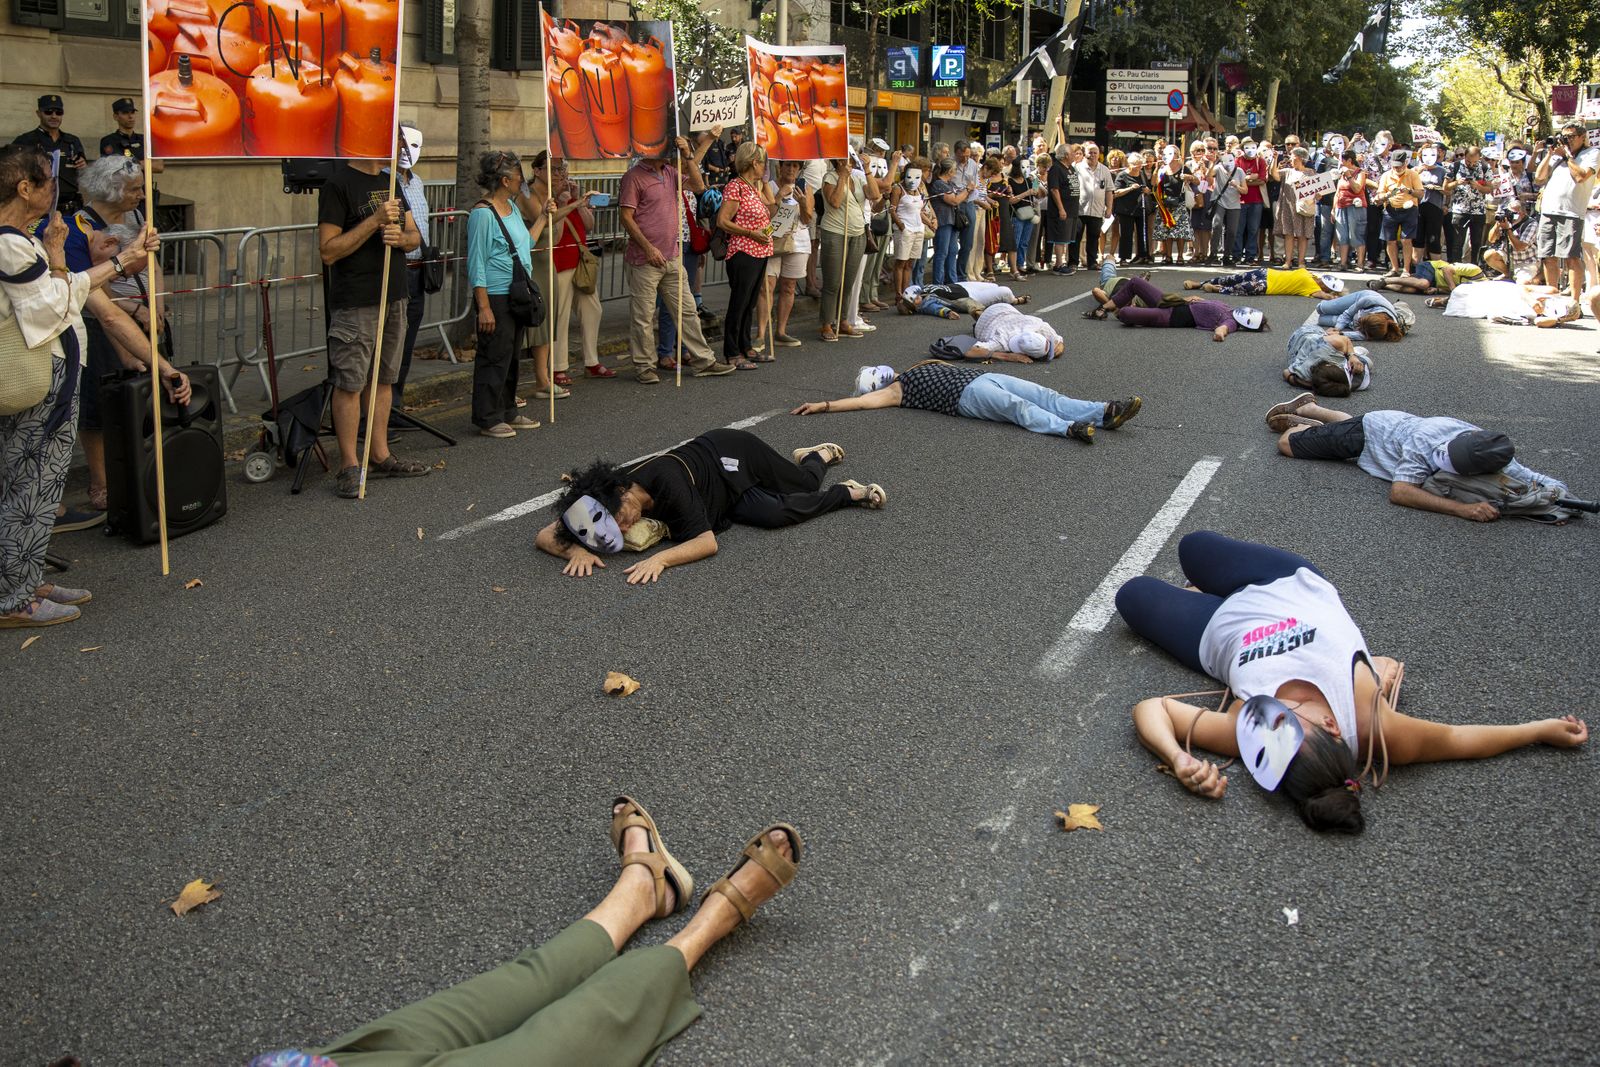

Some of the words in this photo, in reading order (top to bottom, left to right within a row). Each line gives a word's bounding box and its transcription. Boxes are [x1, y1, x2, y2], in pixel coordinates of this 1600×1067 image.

[217, 2, 325, 87] CNI
[945, 59, 958, 75] P
[1128, 83, 1165, 91] Urquinaona
[560, 67, 618, 115] CNI
[1238, 627, 1317, 667] ACTIVE
